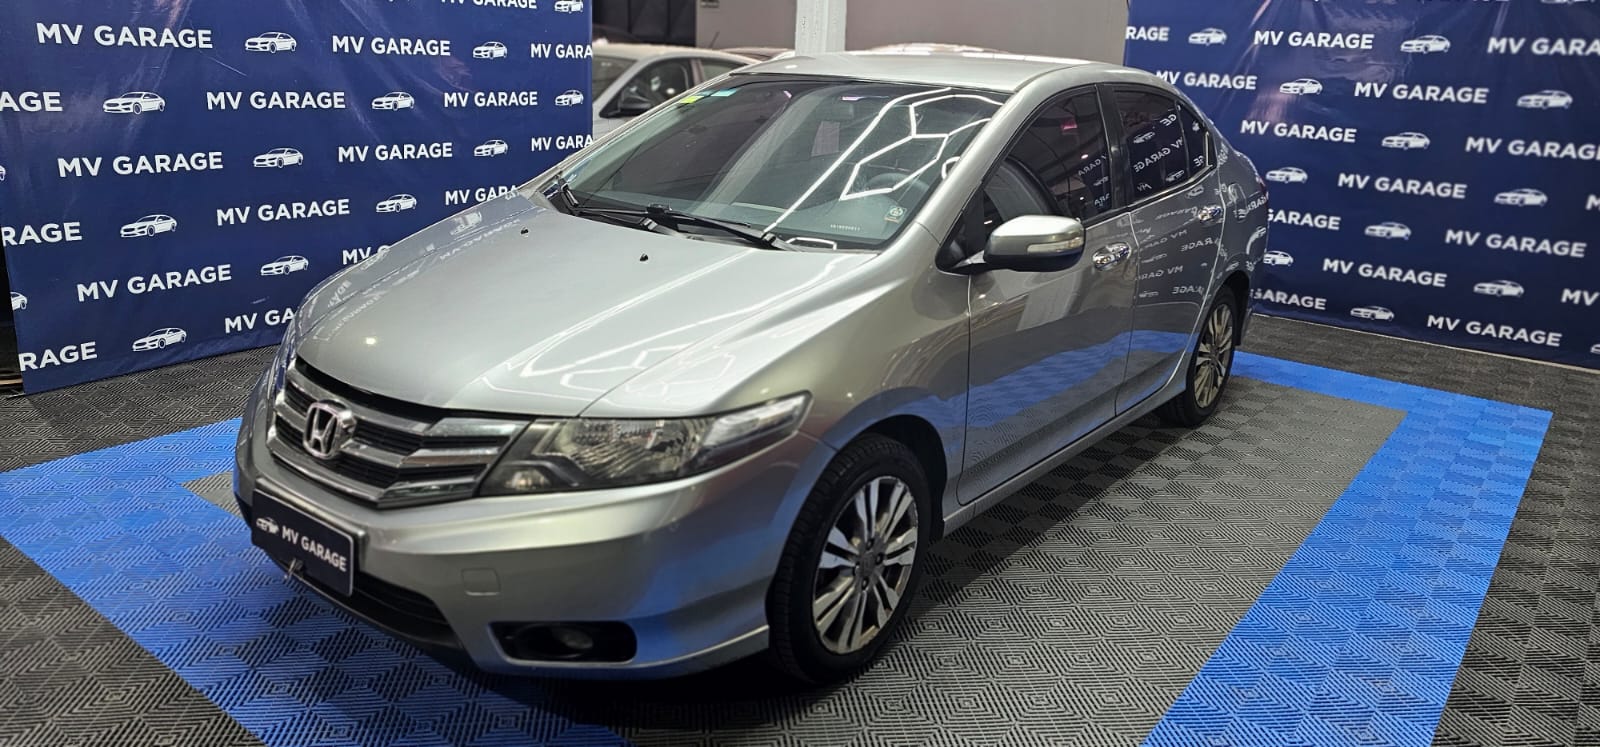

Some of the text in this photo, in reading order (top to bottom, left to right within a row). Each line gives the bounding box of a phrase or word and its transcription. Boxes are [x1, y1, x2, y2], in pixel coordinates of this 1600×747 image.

[37, 23, 212, 48] MV GARAGE
[1126, 26, 1170, 42] RAGE
[1254, 31, 1374, 49] MV GARAGE
[333, 36, 450, 56] MV GARAGE
[531, 44, 551, 58] MV
[1488, 37, 1525, 53] MV
[1184, 72, 1257, 89] GARAGE
[207, 92, 345, 109] MV GARAGE
[445, 92, 537, 107] MV GARAGE
[1355, 82, 1488, 103] MV GARAGE
[1241, 120, 1356, 142] MV GARAGE
[339, 143, 452, 162] MV GARAGE
[532, 137, 551, 151] MV
[1466, 137, 1600, 160] MV GARAG
[58, 152, 223, 177] MV GARAGE
[1338, 173, 1467, 198] MV GARAGE
[446, 190, 470, 205] MV
[217, 199, 349, 225] MV GARAGE
[2, 222, 82, 246] RAGE
[1446, 230, 1586, 257] MV GARAGE
[343, 247, 371, 265] MV
[77, 264, 231, 301] MV GARAGE
[1323, 259, 1447, 287] MV GARAGE
[1562, 289, 1599, 305] MV
[225, 313, 257, 333] MV
[1428, 315, 1562, 346] MV GARAGE
[19, 342, 97, 371] RAGE
[283, 526, 347, 572] MV GARAGE
